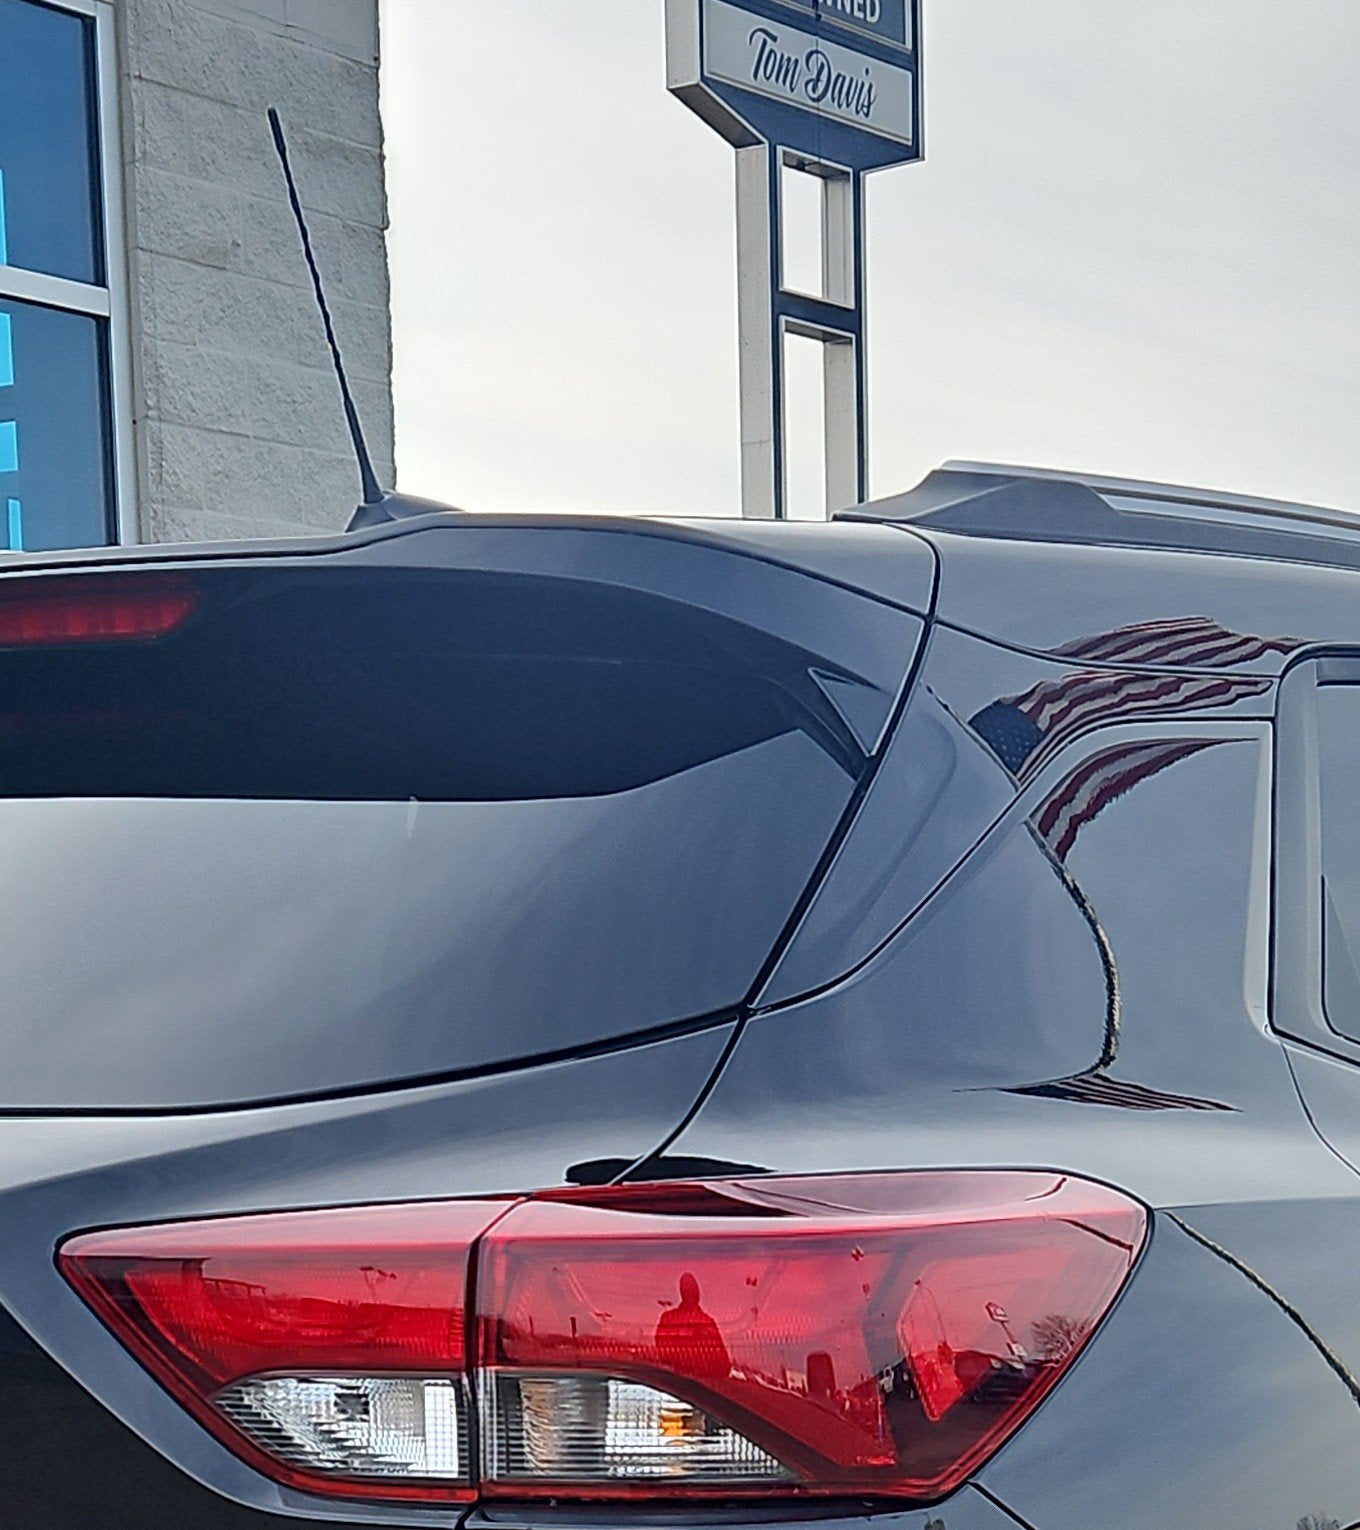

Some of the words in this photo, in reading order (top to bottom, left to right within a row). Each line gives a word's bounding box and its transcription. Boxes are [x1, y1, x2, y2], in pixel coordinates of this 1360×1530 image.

[818, 0, 881, 24] NED
[749, 27, 800, 94] Tom
[805, 49, 877, 119] Davis
